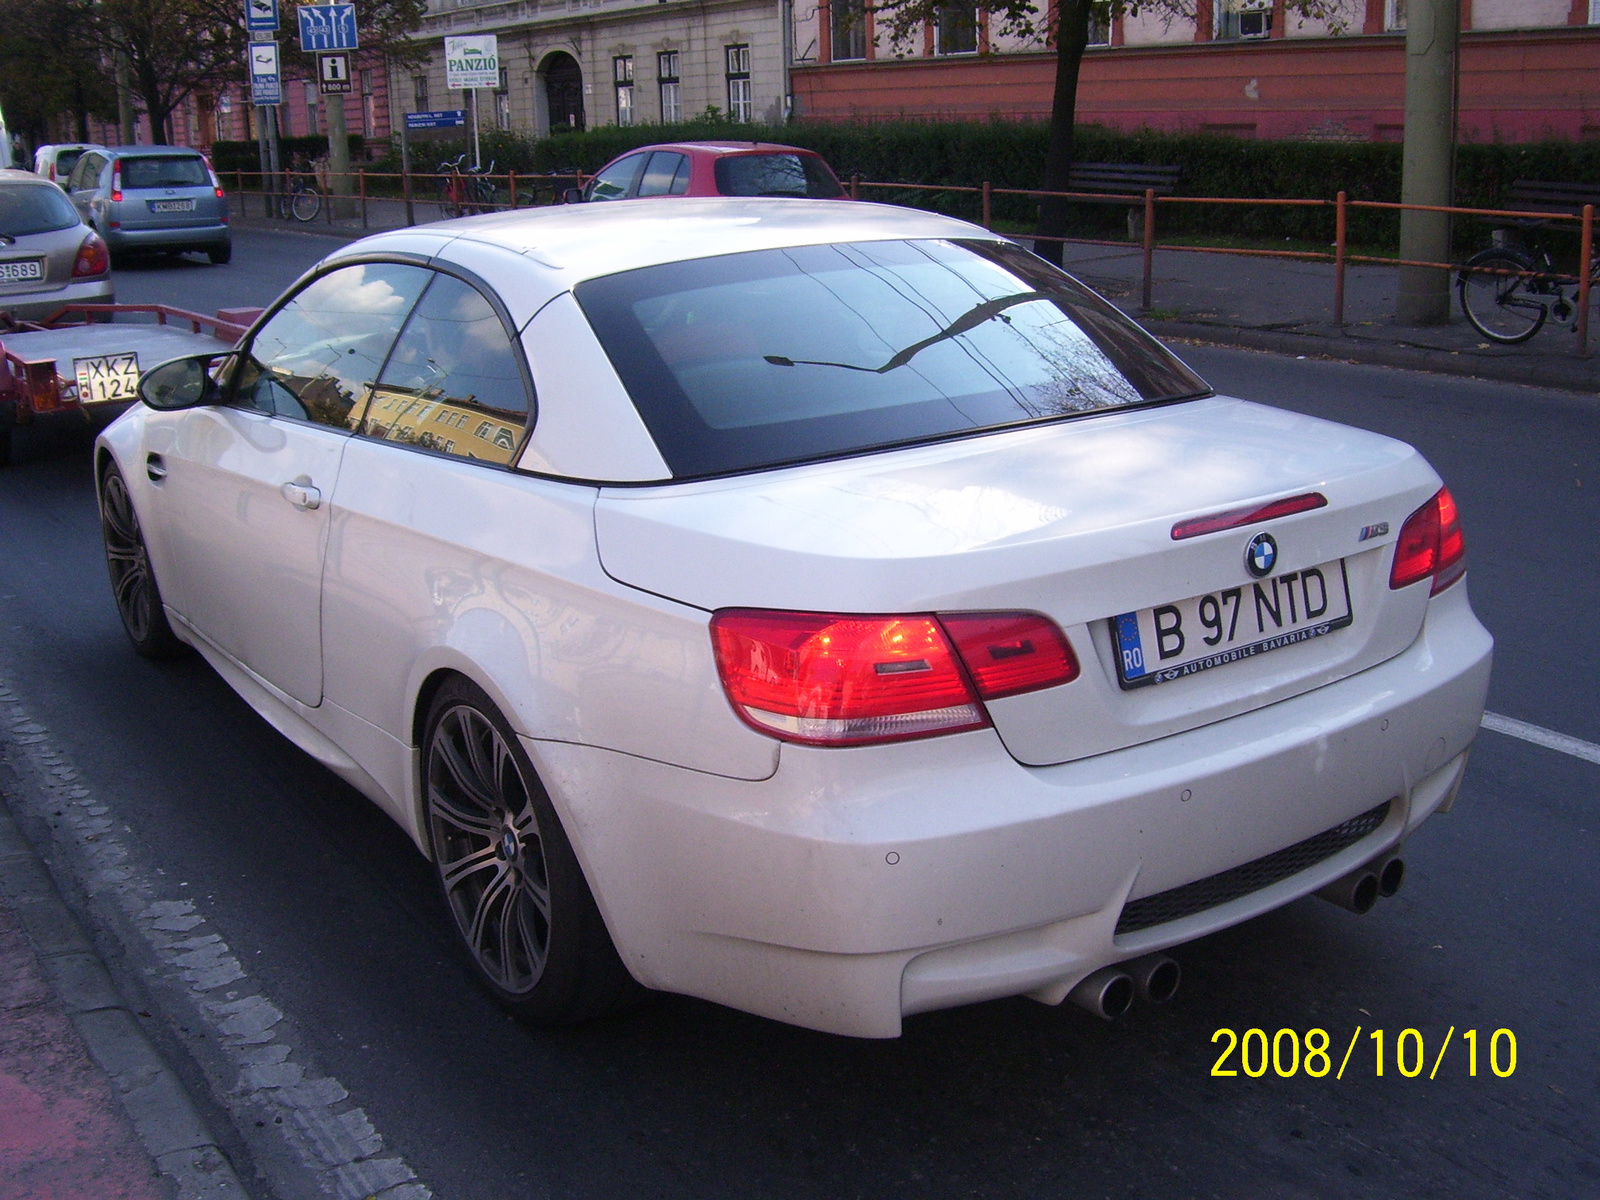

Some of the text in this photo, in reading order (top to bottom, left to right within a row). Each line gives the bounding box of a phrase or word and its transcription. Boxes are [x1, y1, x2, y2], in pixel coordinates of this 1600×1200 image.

[448, 54, 497, 72] PANZIÓ
[327, 83, 341, 91] 800
[90, 356, 136, 379] XKZ
[80, 382, 89, 392] H
[99, 378, 136, 399] 124
[1153, 568, 1328, 661] B 97 NTD
[1123, 646, 1143, 672] RO
[1183, 632, 1307, 676] AUTOMOBILE BAVARIA
